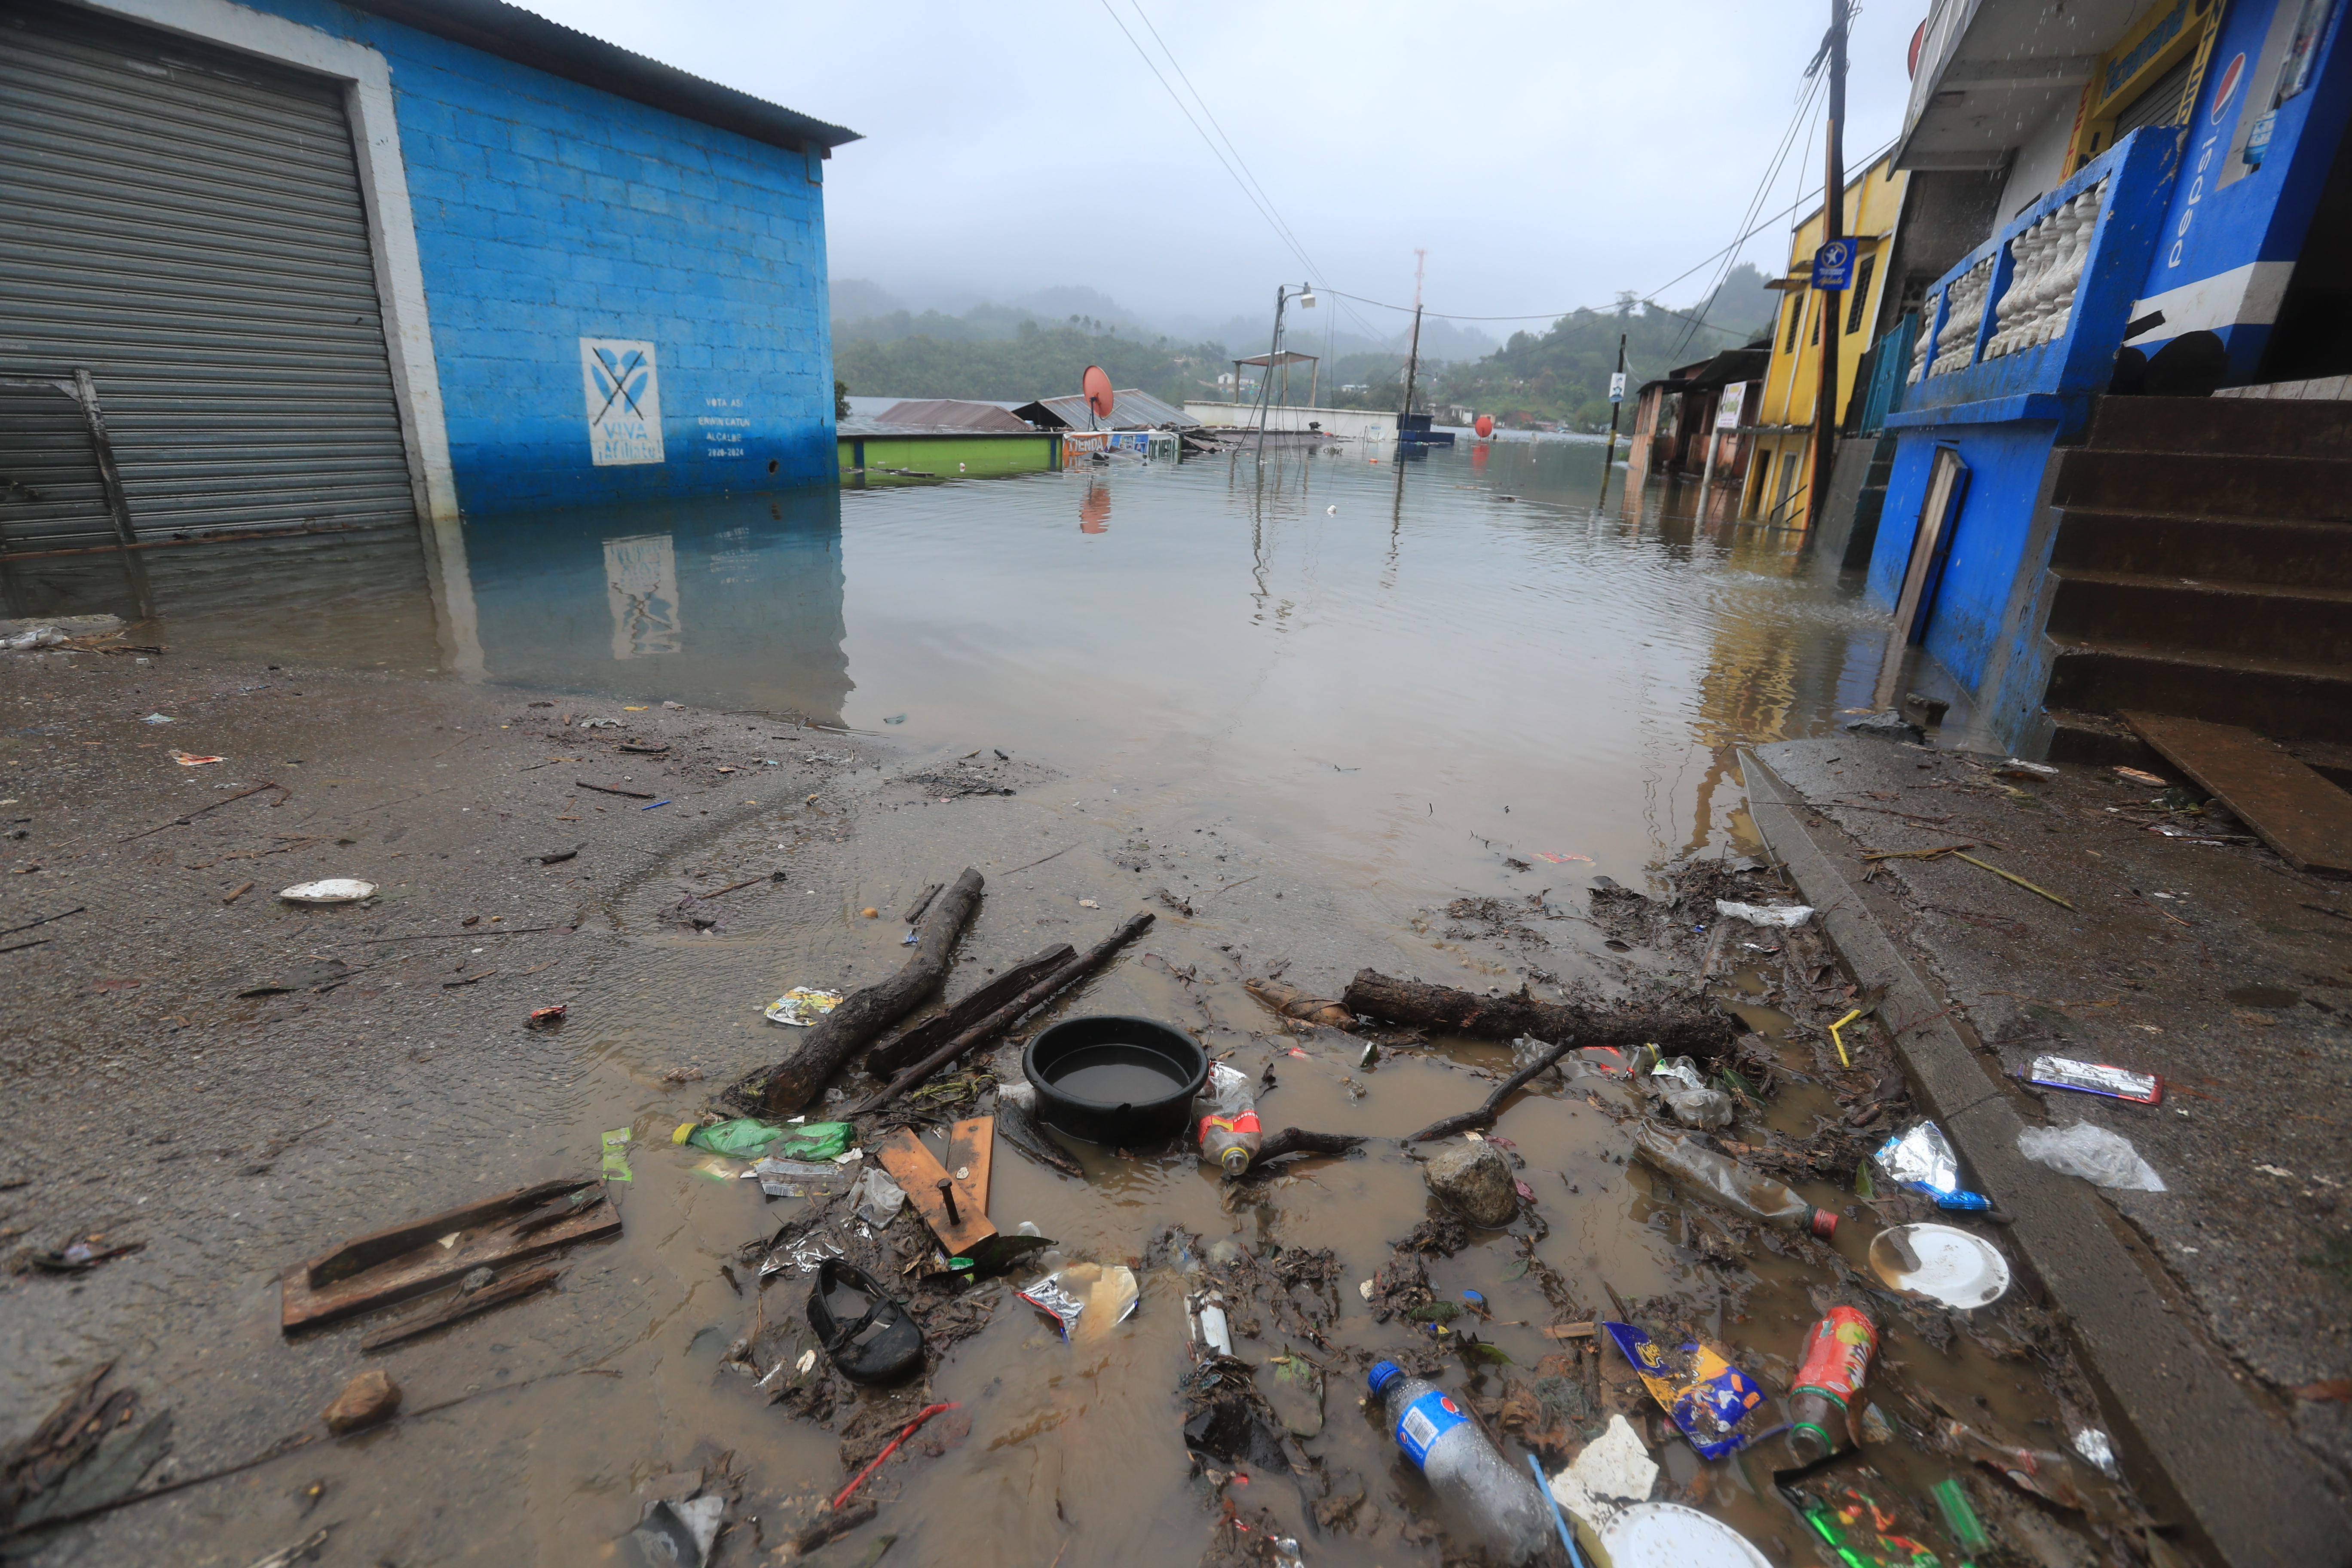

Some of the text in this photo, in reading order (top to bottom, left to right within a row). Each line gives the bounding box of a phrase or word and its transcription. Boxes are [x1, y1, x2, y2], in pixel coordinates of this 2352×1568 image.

[2168, 129, 2219, 268] pepsi
[705, 398, 727, 407] VOTA
[698, 416, 724, 426] ERWIN
[603, 422, 648, 440] VIVA
[1067, 436, 1104, 452] TIENDA
[708, 448, 744, 457] 2020-2024
[1408, 1440, 1424, 1460] pepsi
